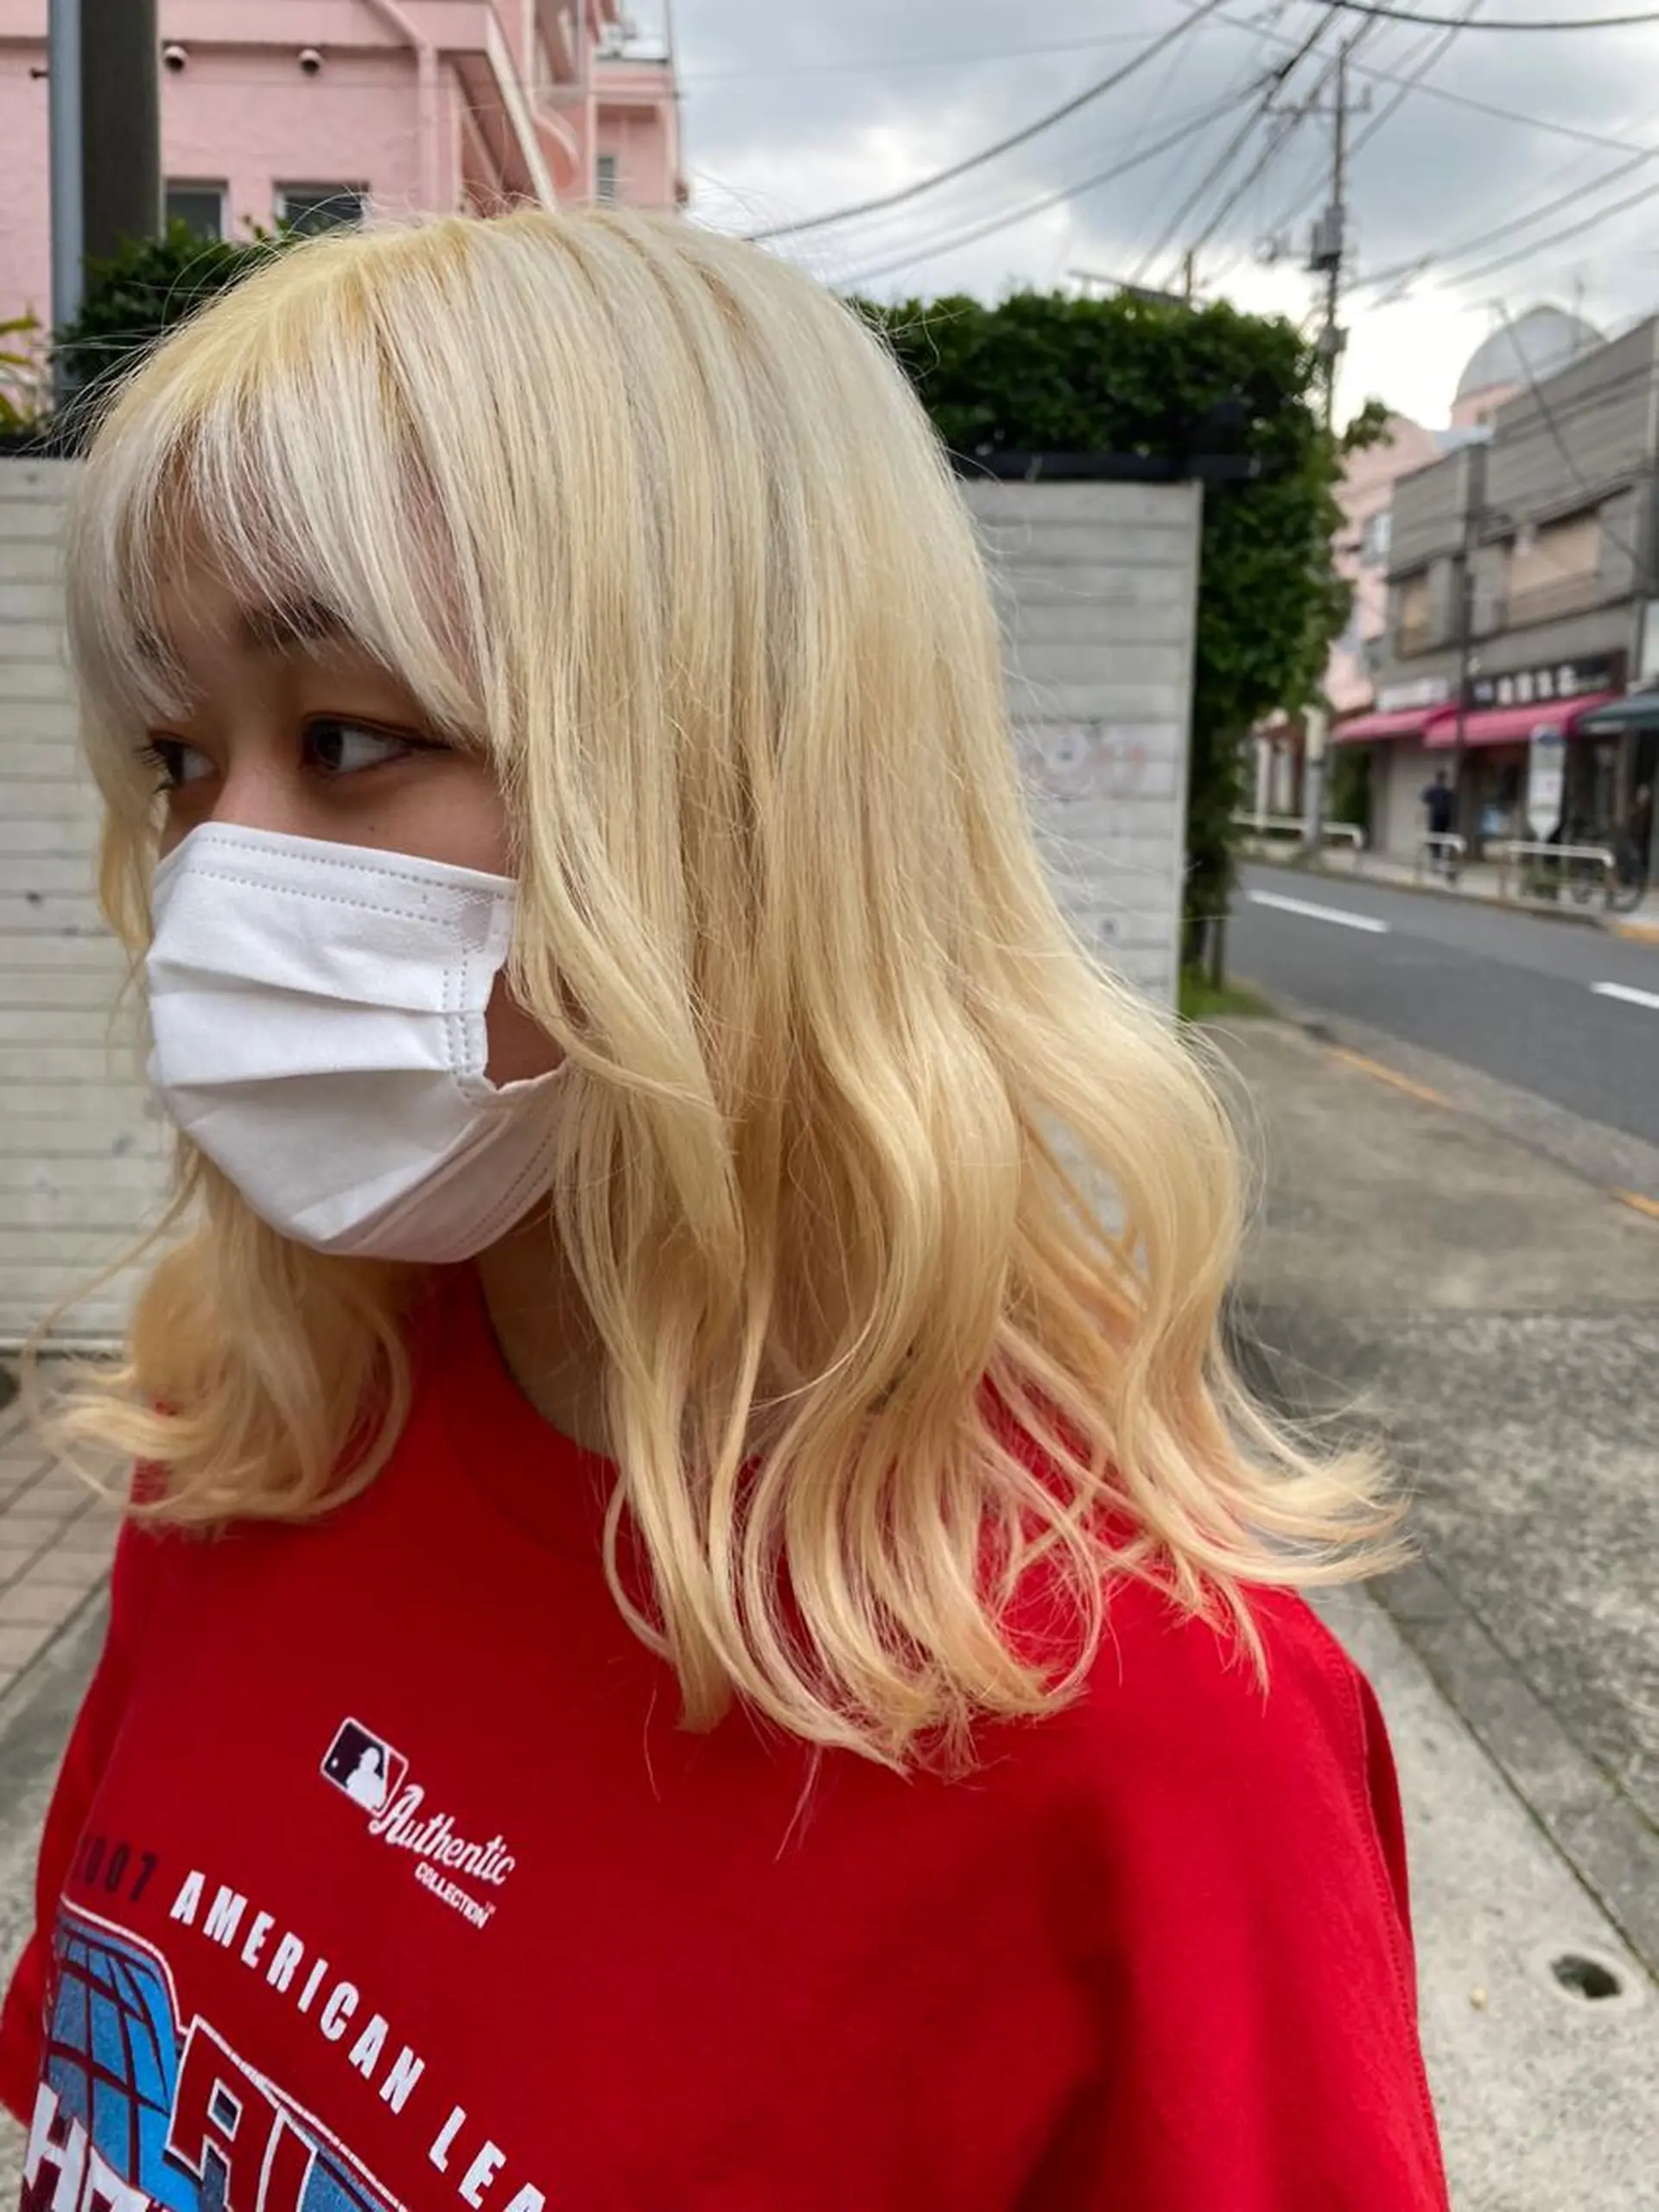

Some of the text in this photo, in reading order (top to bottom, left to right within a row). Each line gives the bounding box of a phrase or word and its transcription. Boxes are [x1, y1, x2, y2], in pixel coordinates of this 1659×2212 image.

[369, 1783, 516, 1885] Authentic
[414, 1860, 492, 1930] COLLECTION
[169, 1869, 426, 2114] AMERICAN
